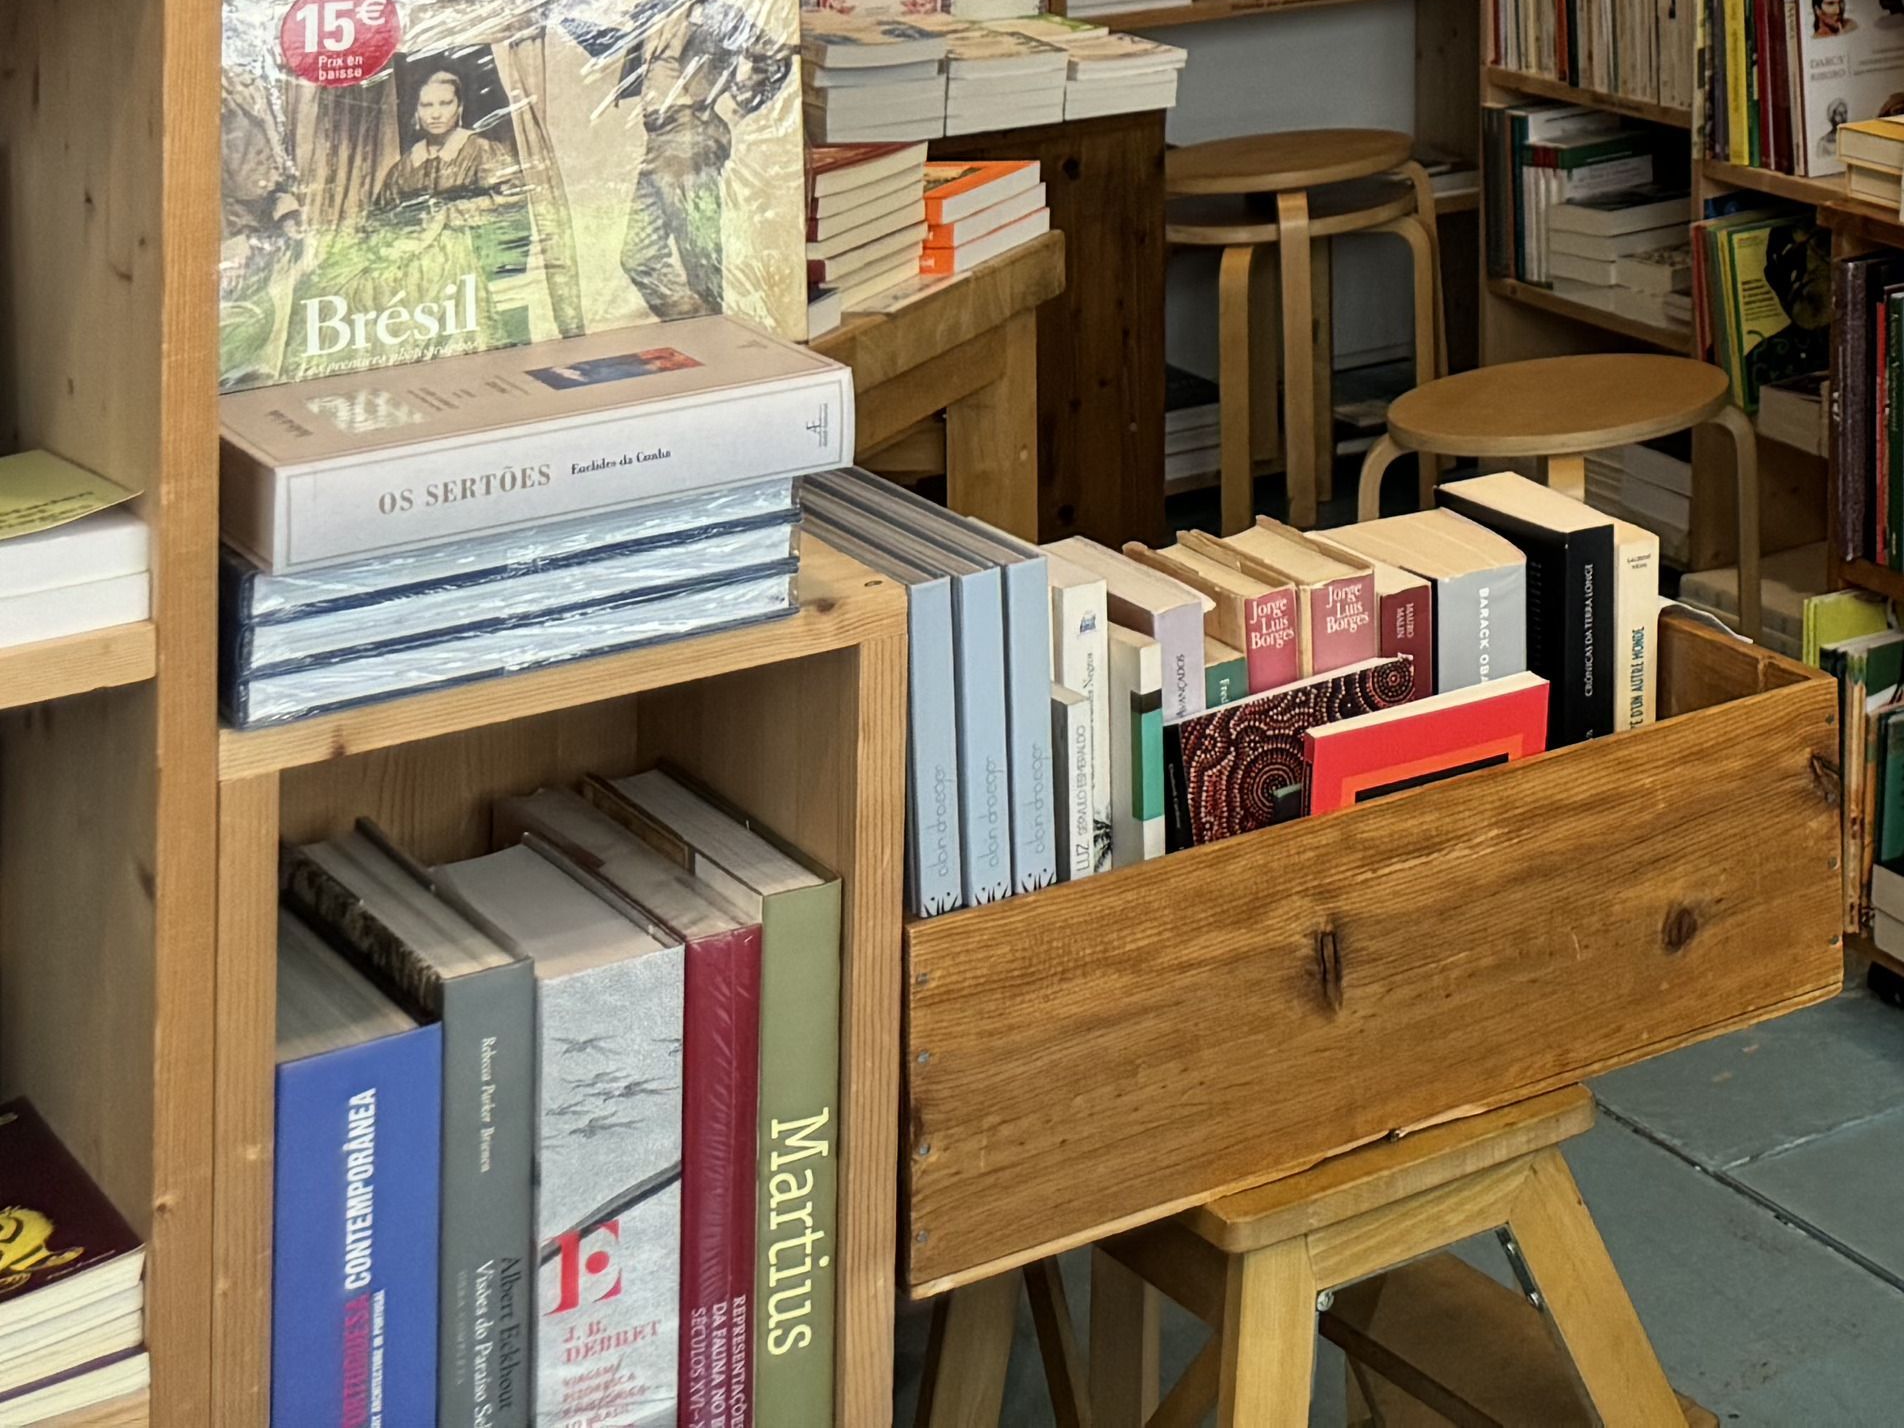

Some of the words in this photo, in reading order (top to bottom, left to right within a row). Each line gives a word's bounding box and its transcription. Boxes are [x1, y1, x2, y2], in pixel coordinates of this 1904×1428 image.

[317, 67, 363, 81] baisse
[318, 55, 343, 68] Prix
[302, 274, 479, 359] Brésil
[379, 490, 416, 516] OS
[424, 463, 552, 508] SERTÕES
[1327, 583, 1363, 608] Jorge
[1327, 612, 1369, 634] Borges
[1336, 600, 1364, 619] Luis
[1478, 587, 1489, 647] BARACK
[1076, 846, 1090, 872] LUZ
[343, 1088, 377, 1290] CONTEMPORÂNEA
[767, 1107, 831, 1356] Martius
[500, 1257, 522, 1316] Albert
[499, 1322, 522, 1409] Eckhout
[691, 1307, 706, 1375] SÉCULOS
[712, 1324, 727, 1393] FAUNA
